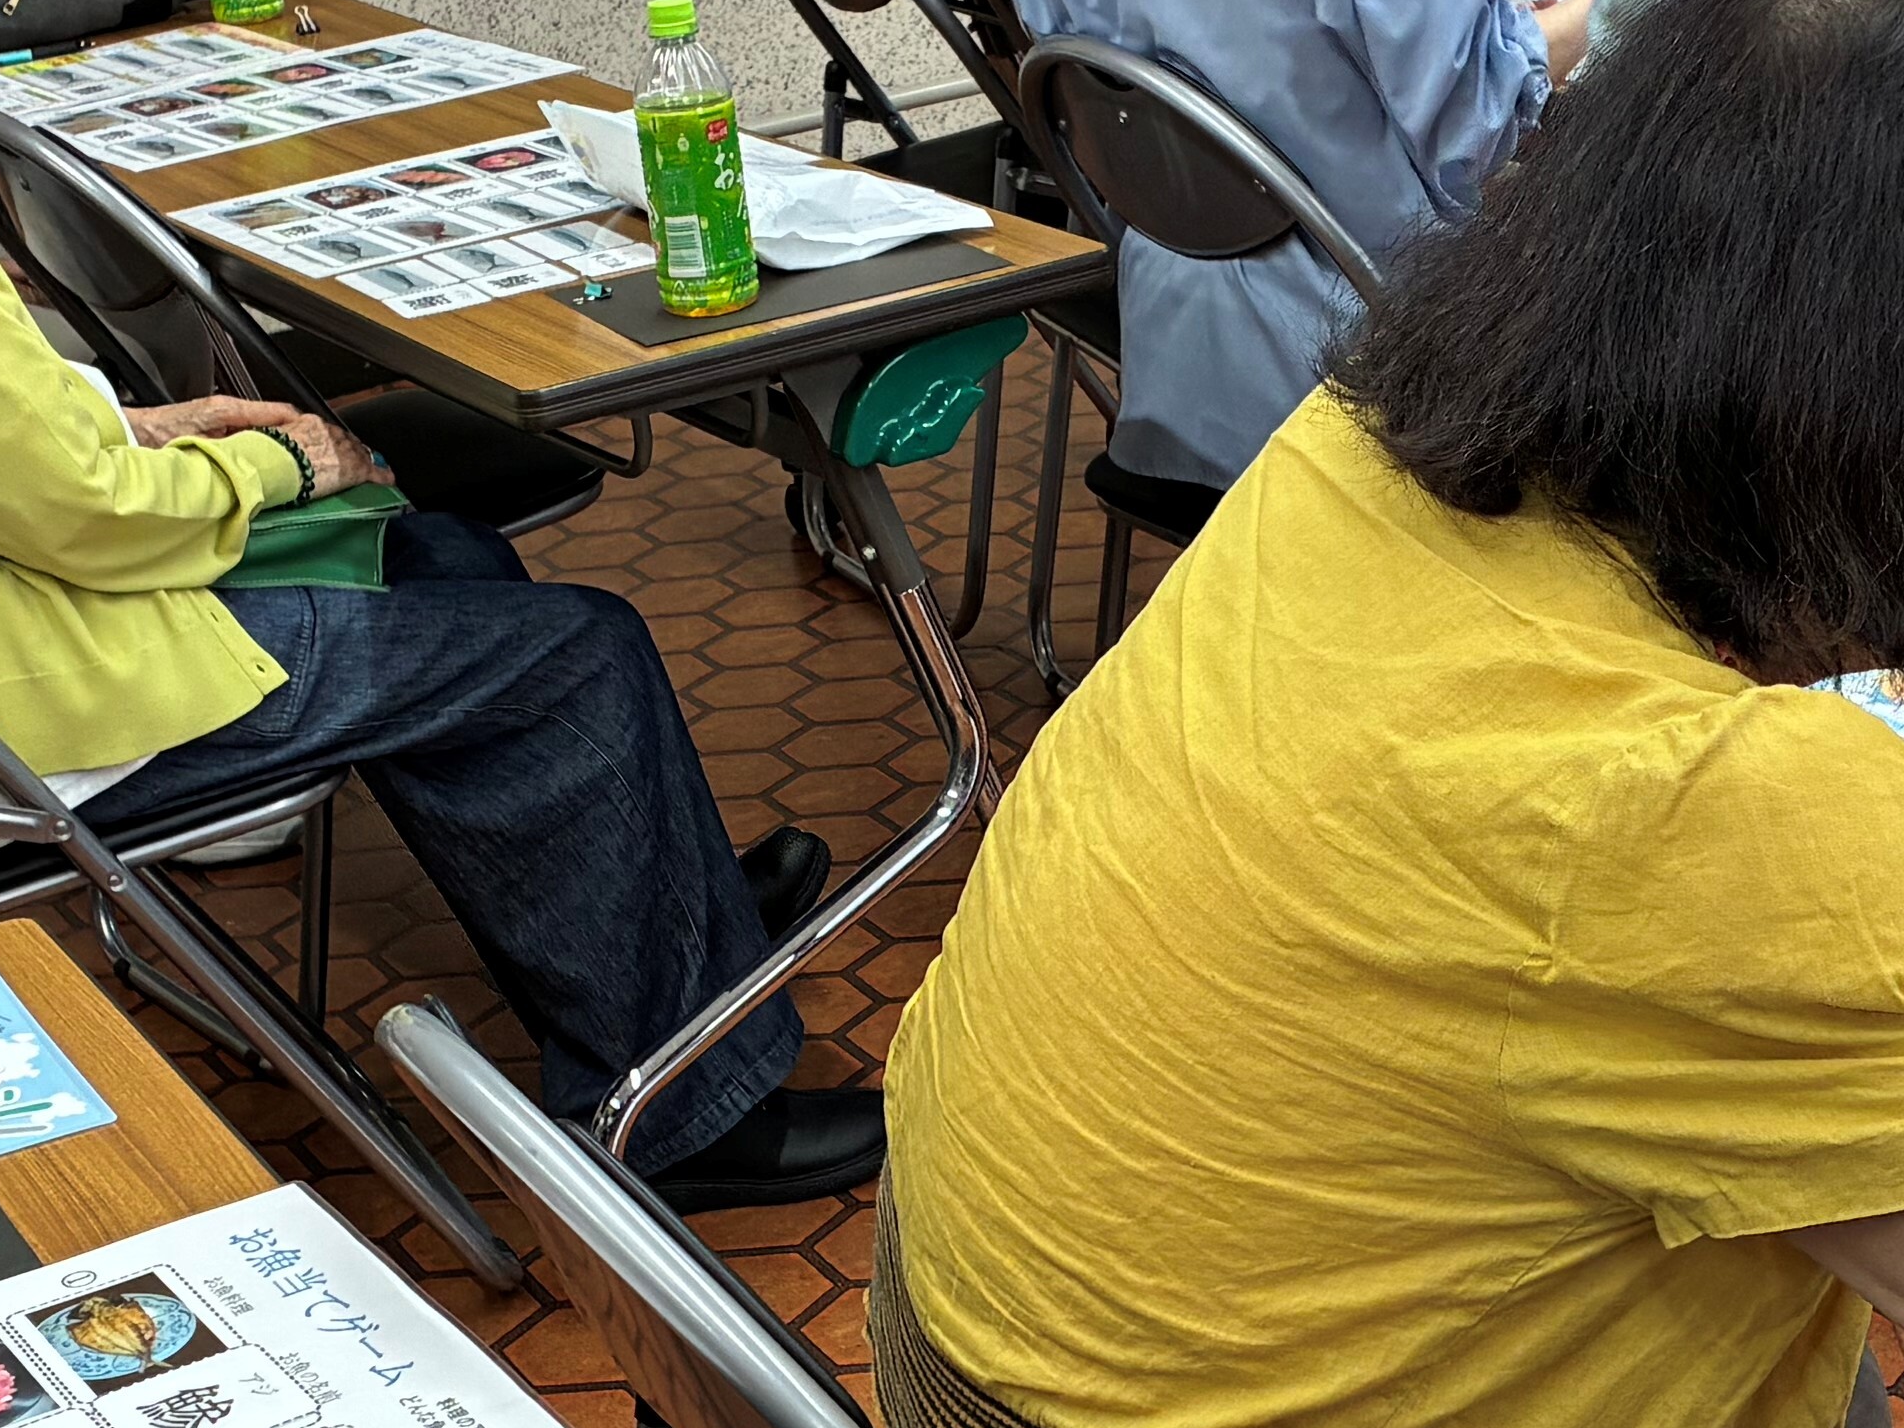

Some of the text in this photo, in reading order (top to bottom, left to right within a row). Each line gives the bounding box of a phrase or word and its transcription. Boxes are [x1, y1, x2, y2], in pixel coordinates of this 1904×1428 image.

[202, 1275, 254, 1318] お魚料理
[228, 1226, 415, 1387] お魚当てゲーム
[239, 1371, 280, 1396] アジ
[279, 1351, 342, 1406] お魚の名前
